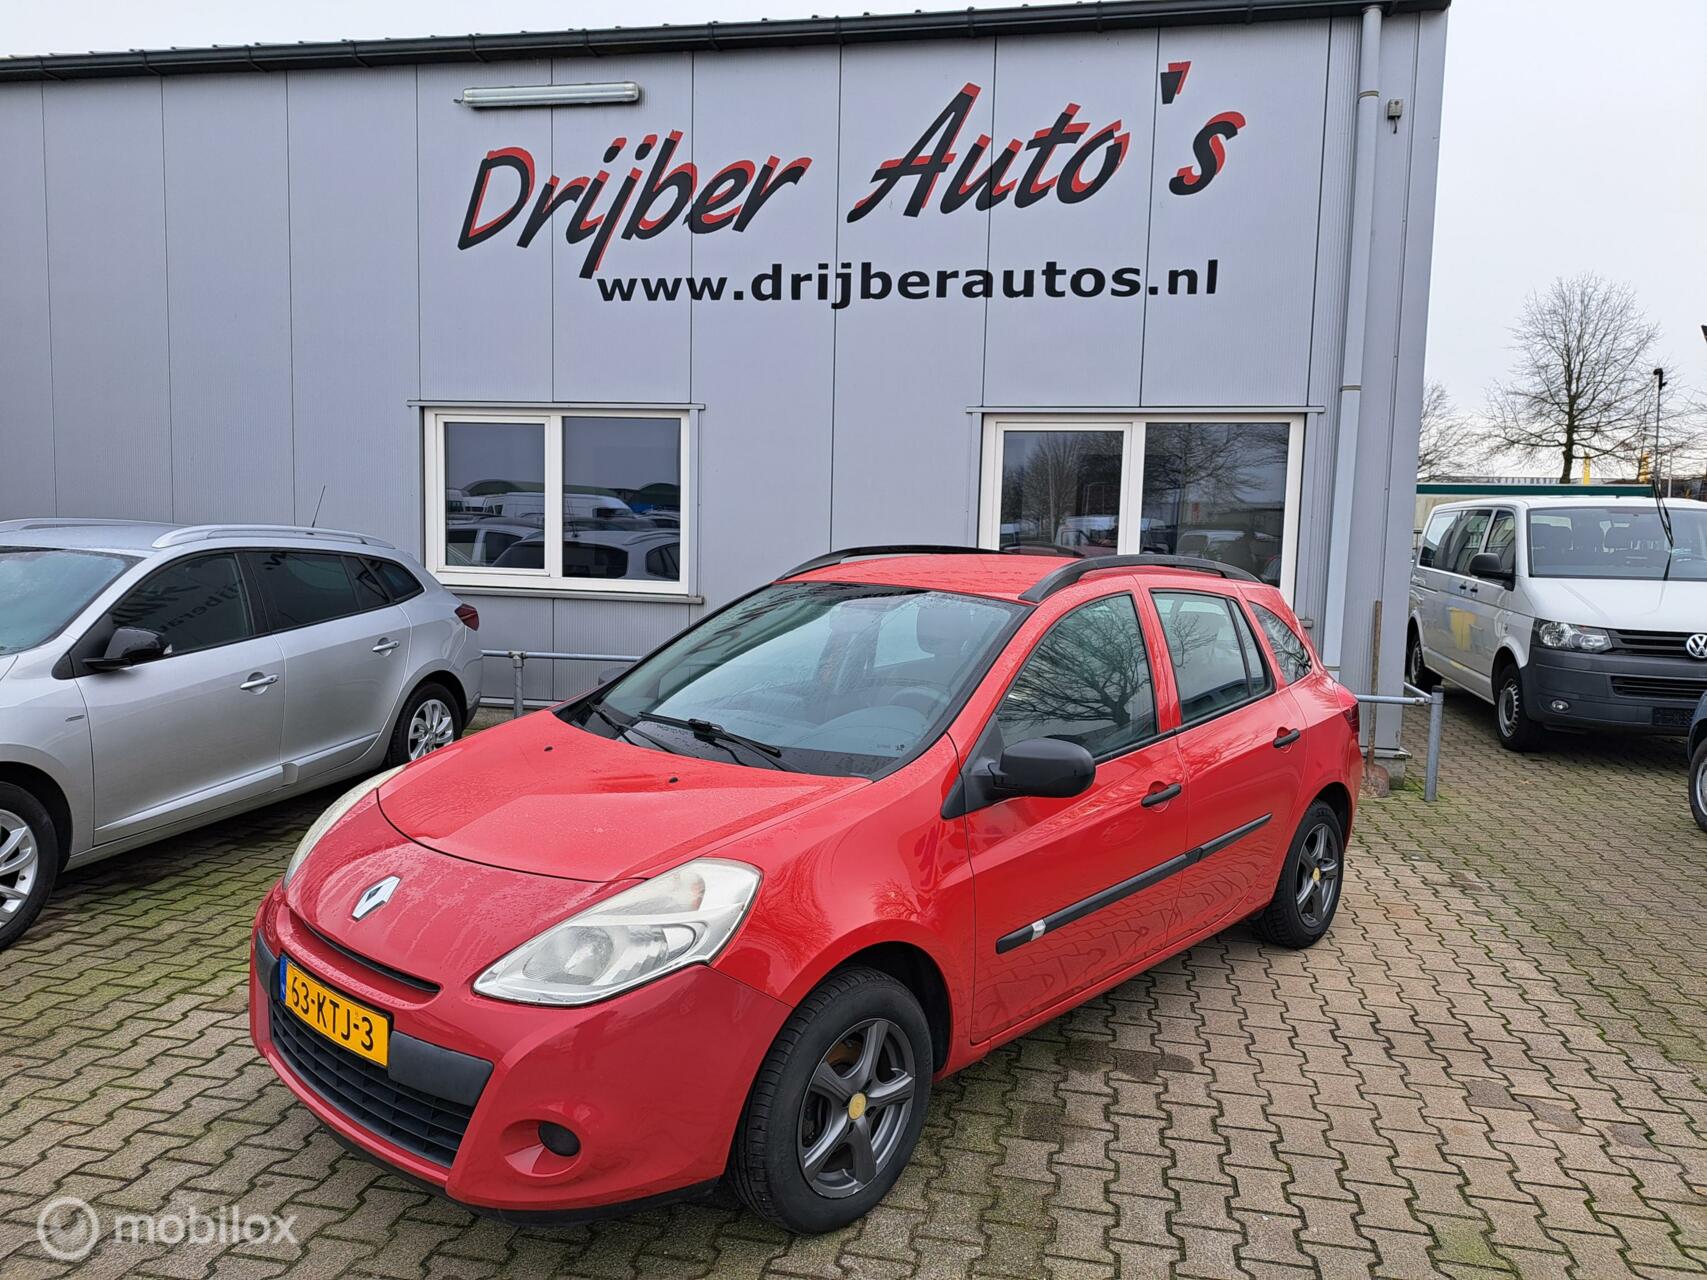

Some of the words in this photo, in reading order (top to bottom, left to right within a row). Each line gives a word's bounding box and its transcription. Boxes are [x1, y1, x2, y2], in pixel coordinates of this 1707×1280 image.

[458, 129, 813, 279] Drijber
[846, 61, 1246, 223] Auto's
[597, 260, 1218, 309] www.drijberautos.nl
[291, 976, 374, 1051] 63-KTJ-3
